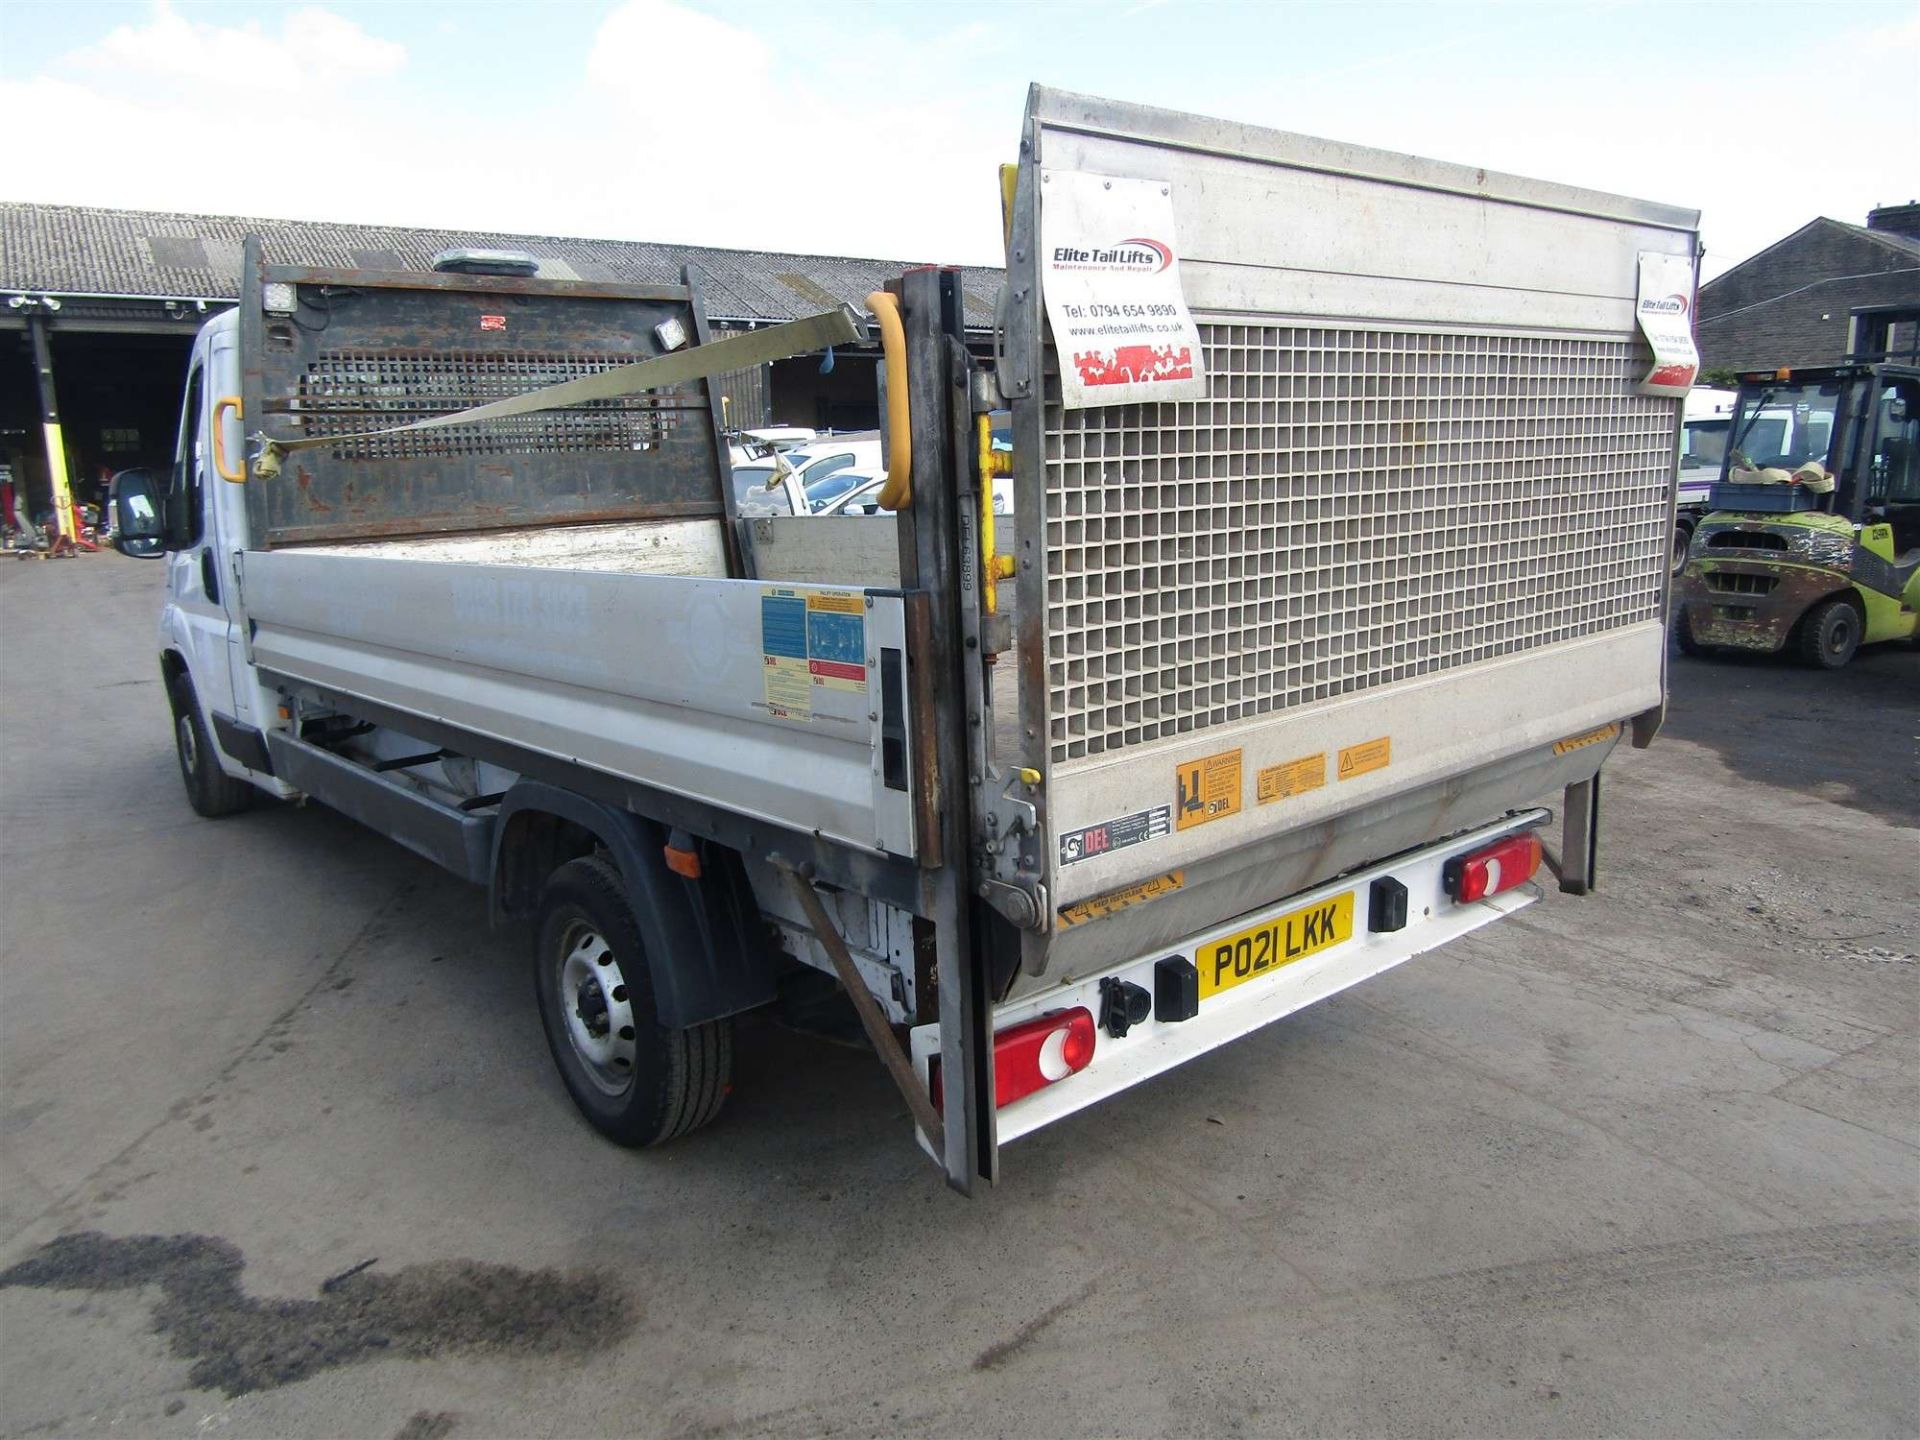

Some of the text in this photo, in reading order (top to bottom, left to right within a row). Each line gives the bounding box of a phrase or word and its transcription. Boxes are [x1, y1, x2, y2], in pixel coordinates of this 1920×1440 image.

[1053, 247, 1154, 264] Elite Tail Lifts
[1053, 263, 1107, 272] Maintenance
[1062, 303, 1177, 318] Tel: 0794 654 9890
[1069, 322, 1184, 336] www.elitetaillifts.co.uk
[1217, 797, 1230, 811] DEL
[1084, 828, 1109, 854] DEL
[1214, 926, 1279, 987] PO21
[1285, 903, 1337, 958] LKK
